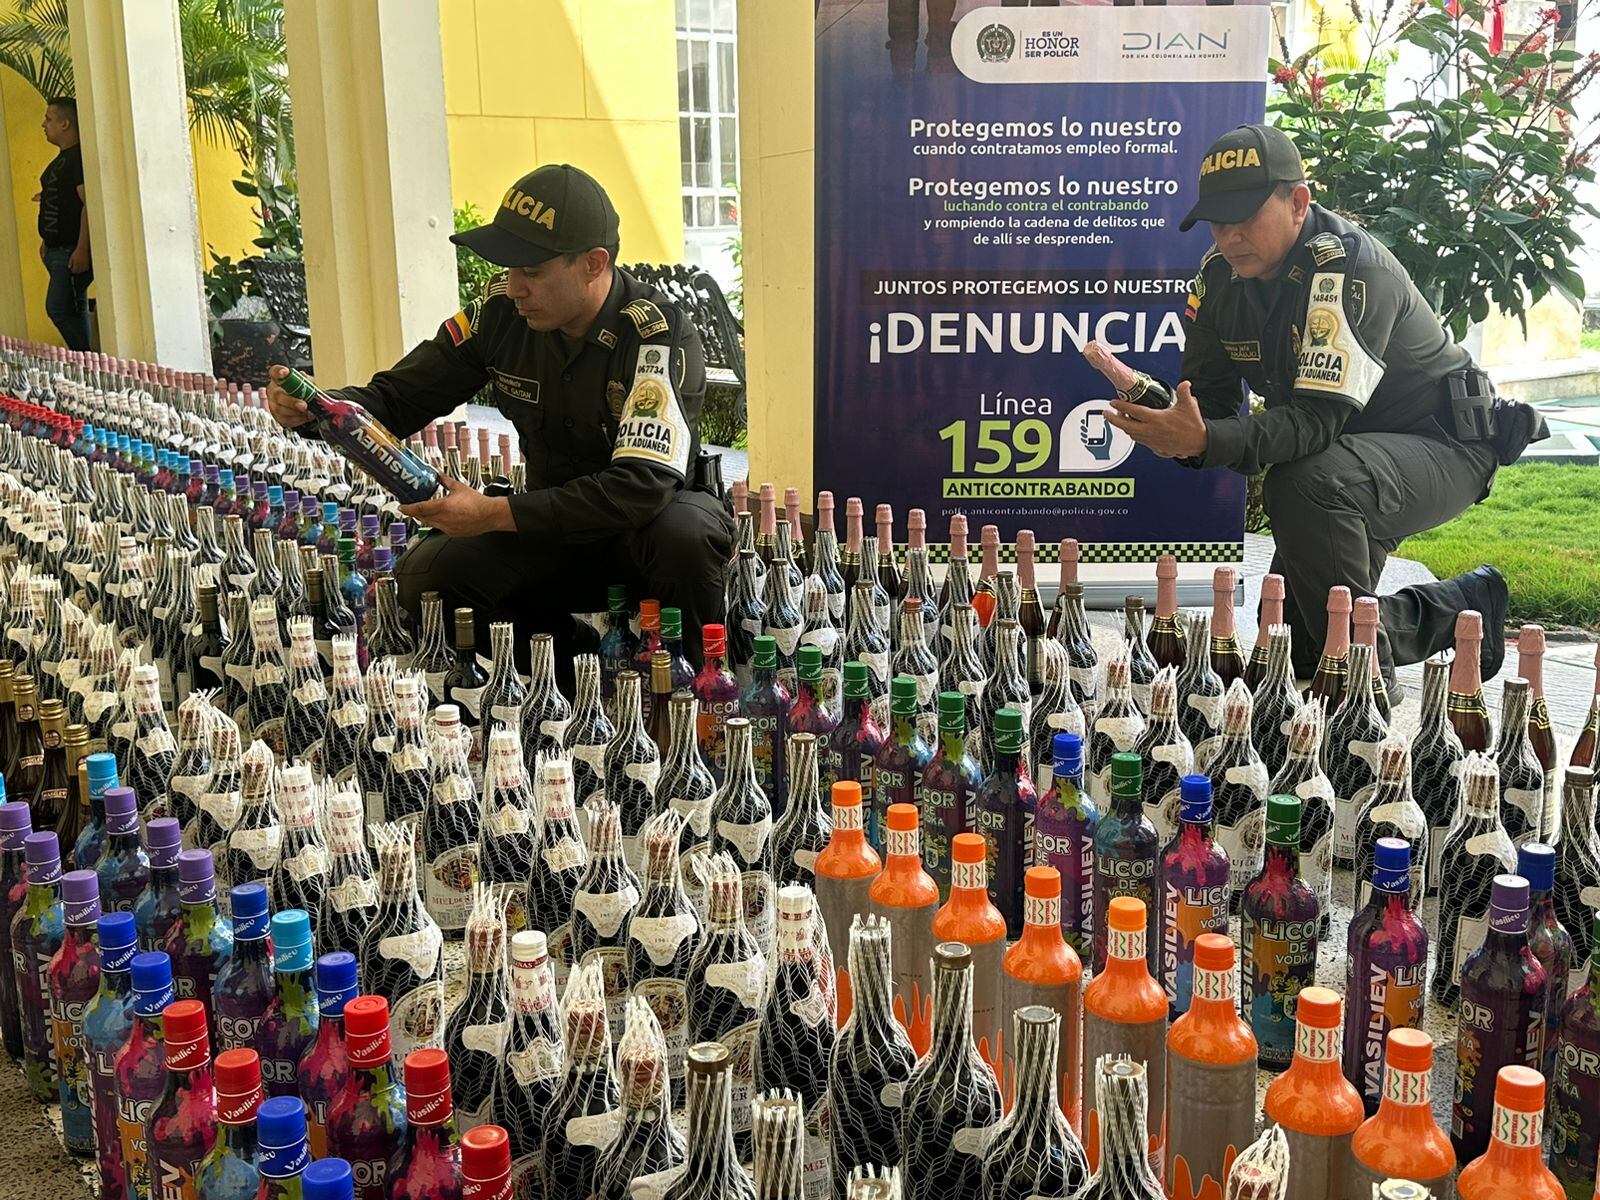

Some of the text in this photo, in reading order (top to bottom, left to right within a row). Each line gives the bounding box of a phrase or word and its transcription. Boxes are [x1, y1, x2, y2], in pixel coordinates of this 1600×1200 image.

[1025, 37, 1079, 49] HONOR
[1122, 32, 1228, 50] DIAN
[1043, 49, 1079, 58] POLICÍA
[909, 116, 1182, 141] Protegemos lo nuestro
[913, 140, 1178, 157] cuando contratamos empleo formal.
[1199, 148, 1260, 177] OLICIA
[908, 175, 1178, 200] Protegemos lo nuestro
[503, 188, 556, 230] LICIA
[943, 199, 1149, 212] luchando contra el contrabando
[924, 216, 1165, 230] y rompiendo la cadena de delitos que
[973, 232, 1114, 247] de allí se desprenden.
[873, 280, 947, 295] JUNTOS
[952, 280, 1079, 295] PROTEGEMOS
[1084, 280, 1108, 294] LO
[1313, 294, 1338, 303] 148451
[869, 311, 1187, 364] ¡DENUNCIA
[1298, 351, 1343, 371] OLICIA
[1305, 368, 1341, 383] ADUANERA
[980, 391, 1052, 416] Línea
[619, 422, 671, 444] OLICIA
[632, 439, 670, 455] ADUANERA
[938, 418, 1052, 474] 159
[350, 427, 420, 490] VASILIEV
[946, 482, 1130, 496] ANTICONTRABANDO
[750, 717, 777, 730] COR
[922, 789, 957, 809] COR
[1036, 831, 1072, 855] COR
[1098, 857, 1155, 878] LICOR
[1081, 835, 1094, 950] VASILIEV
[1119, 880, 1137, 890] DE
[1185, 884, 1231, 907] LICO
[1212, 906, 1226, 916] DE
[1200, 916, 1229, 929] VODK
[1261, 917, 1317, 942] LICO
[1163, 881, 1178, 1002] VASILIEV
[1289, 942, 1308, 953] DE
[1243, 911, 1255, 1022] ASILIEV
[1275, 953, 1314, 965] VODKA
[1395, 962, 1426, 988] LIC
[51, 1001, 87, 1024] LIC
[1364, 962, 1388, 1096] VASILIEV
[352, 1032, 387, 1059] Vasiliev
[223, 1090, 260, 1120] Vasiliev
[408, 1095, 445, 1121] Vasiliev
